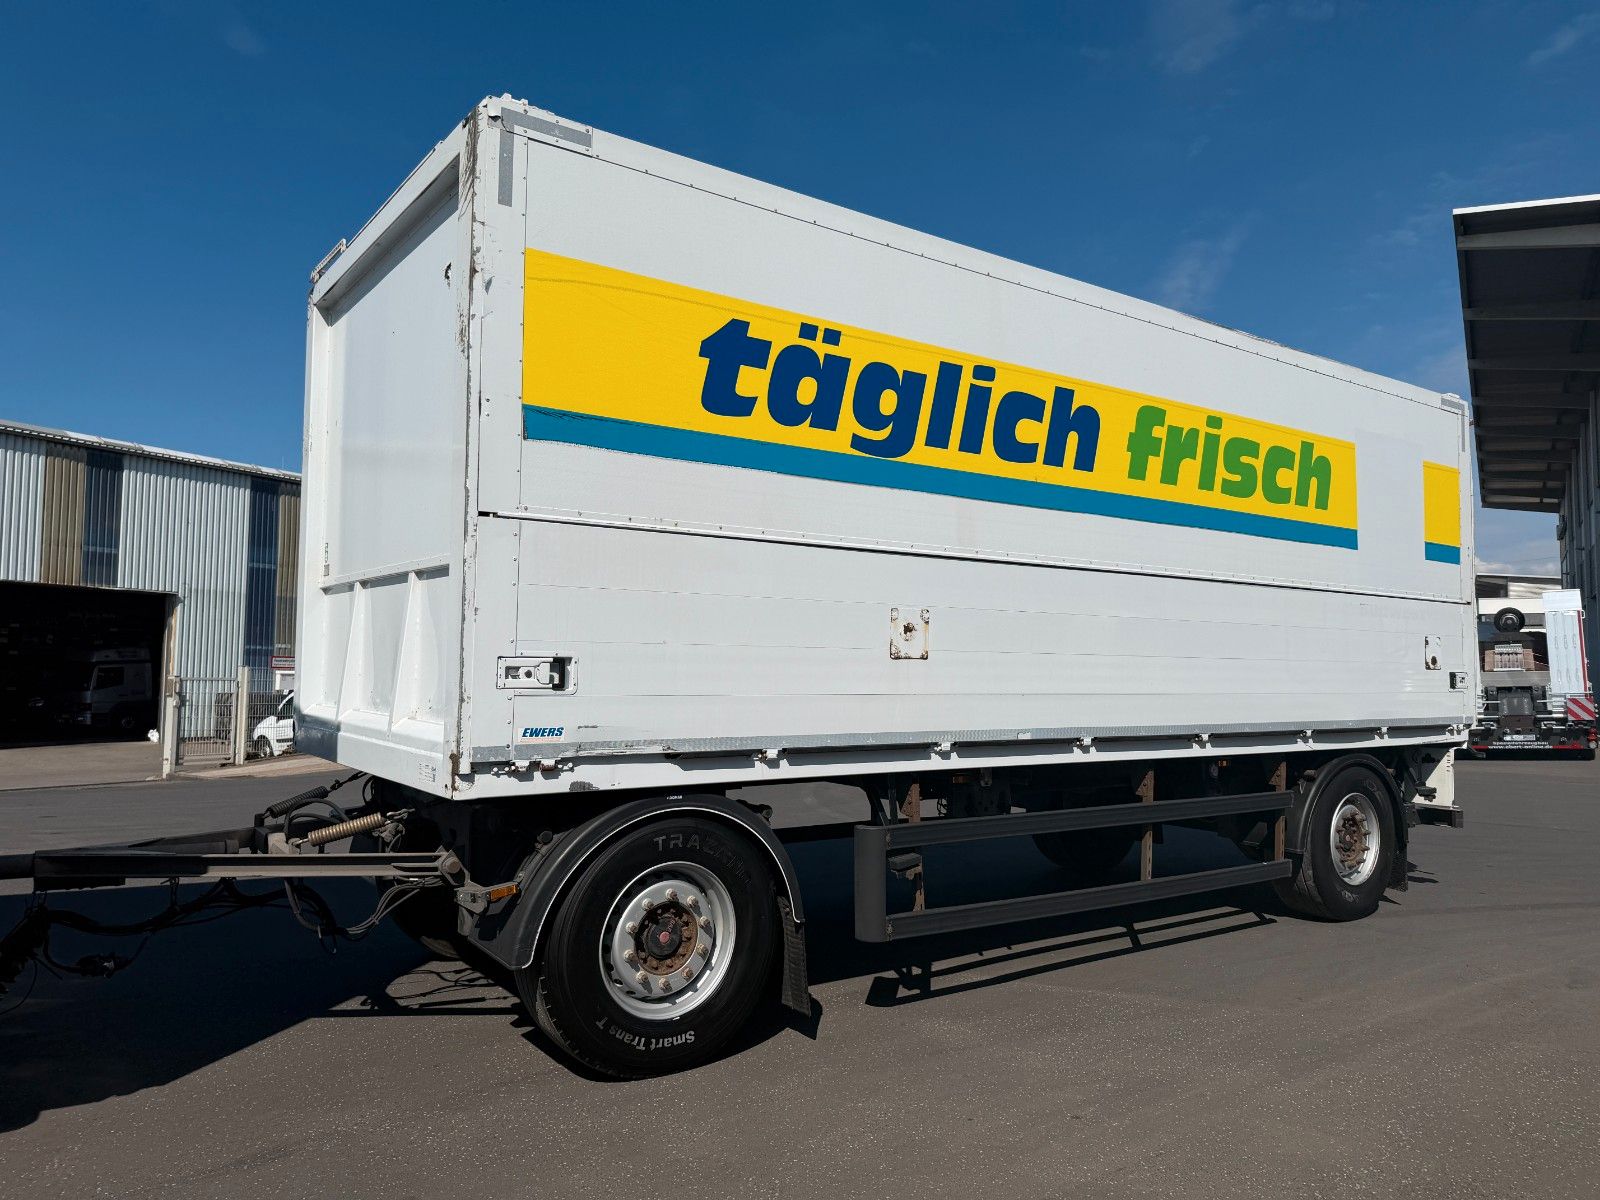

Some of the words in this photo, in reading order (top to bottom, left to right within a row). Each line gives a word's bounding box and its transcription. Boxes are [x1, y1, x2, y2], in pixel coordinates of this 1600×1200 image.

[700, 319, 1101, 471] täglich
[1126, 406, 1332, 510] frisch
[522, 727, 564, 737] EWERS
[609, 1025, 646, 1050] Trans
[650, 1029, 696, 1051] Smart
